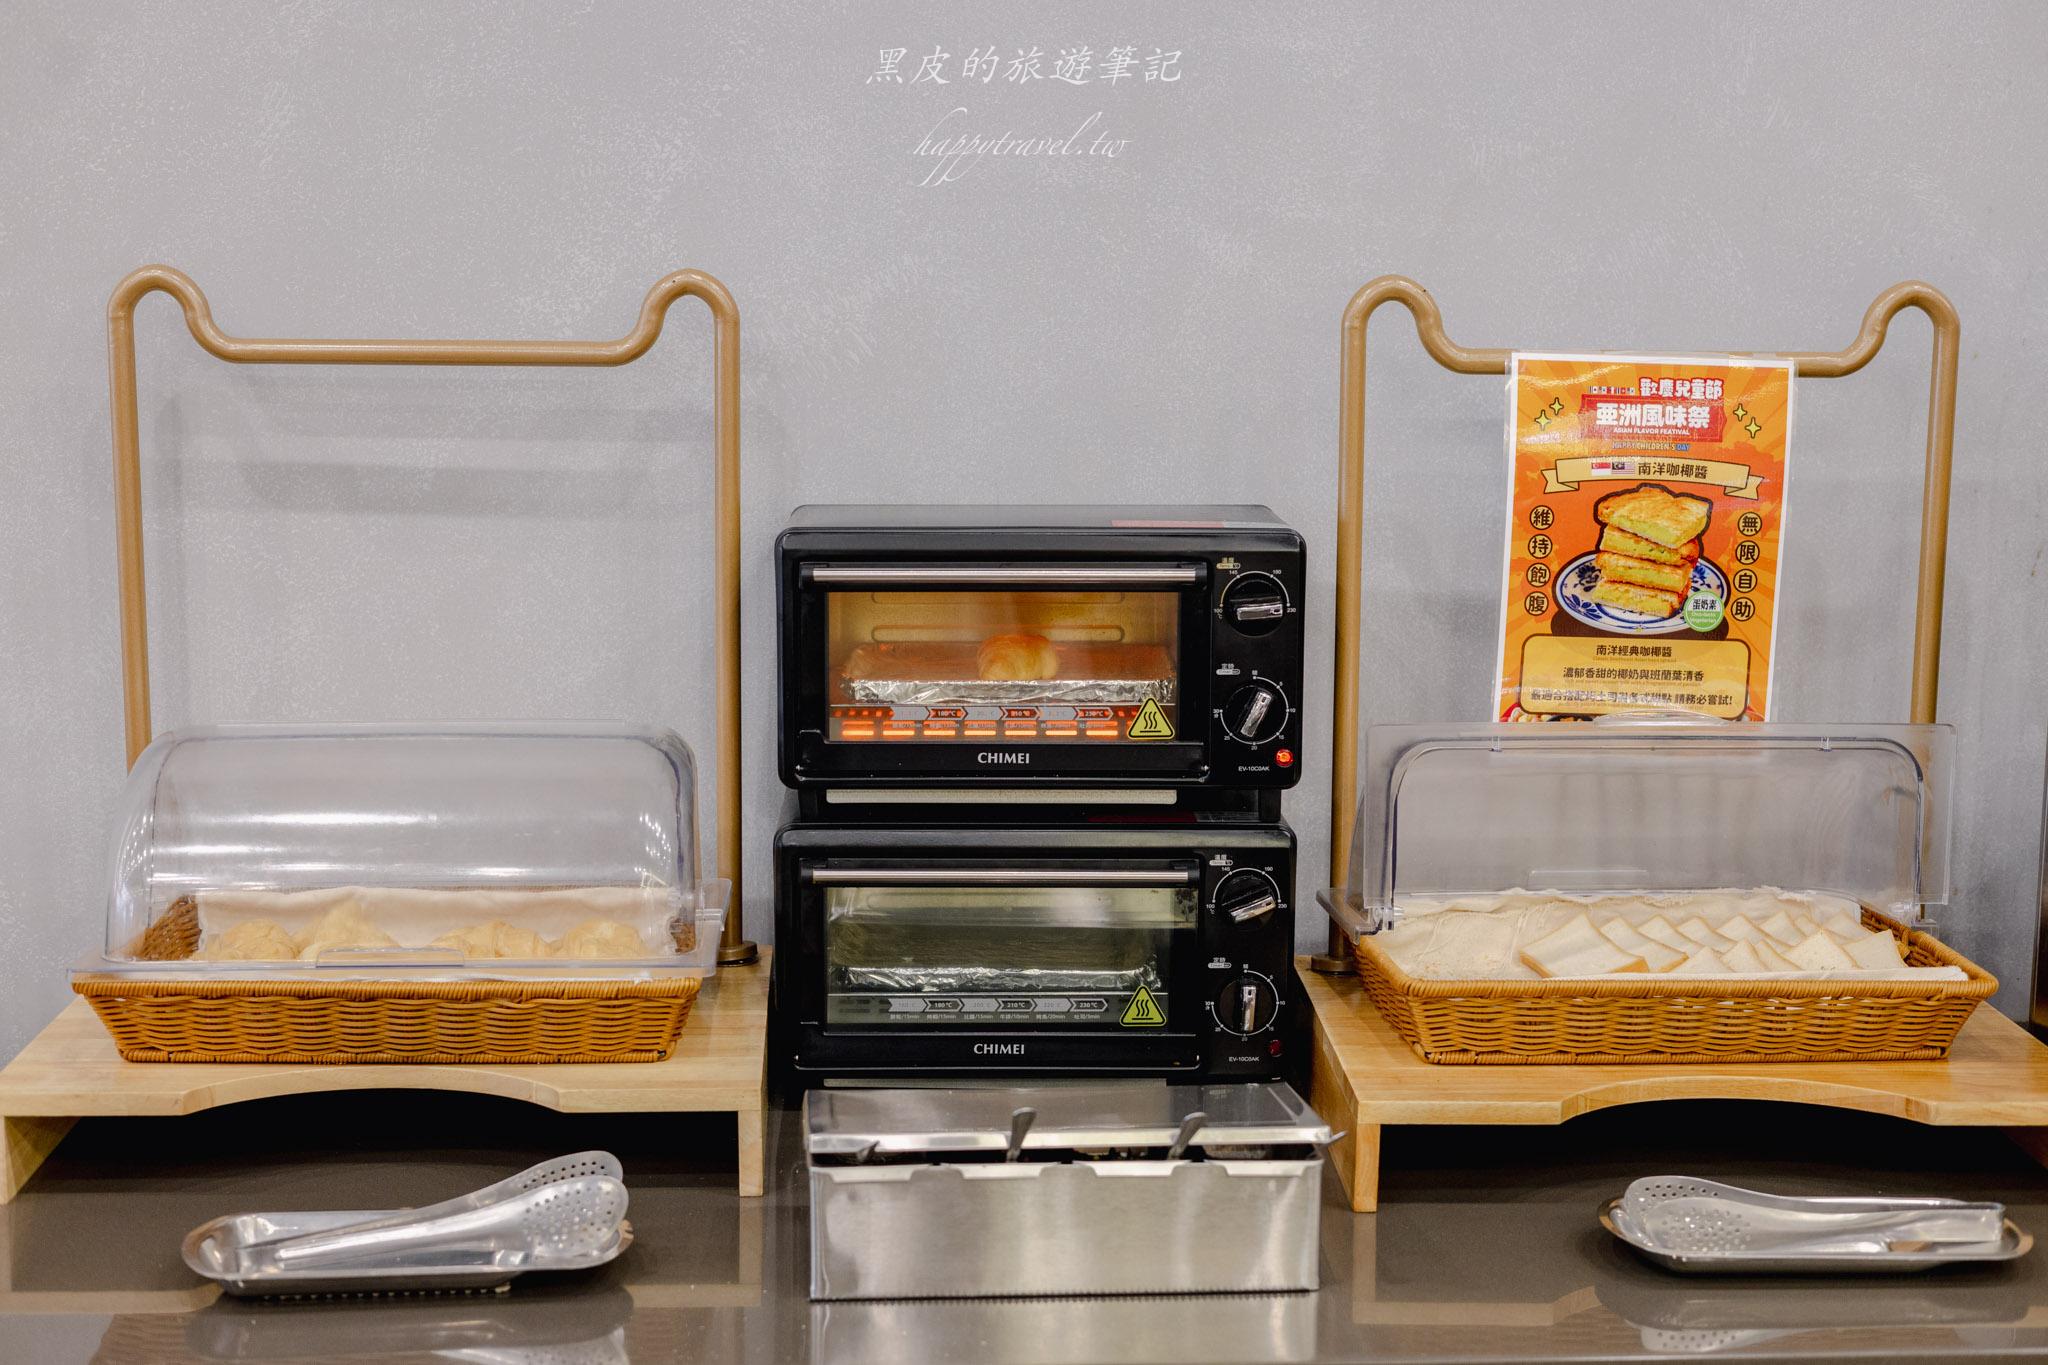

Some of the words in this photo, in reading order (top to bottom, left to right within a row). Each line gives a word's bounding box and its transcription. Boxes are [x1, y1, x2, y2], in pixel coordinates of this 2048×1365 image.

[1640, 377, 1723, 400] 歡慶兒童節
[1638, 462, 1708, 479] 南洋咖椰醬
[1693, 598, 1717, 610] 蛋奶素
[1596, 644, 1672, 657] 南洋經典咖椰醬
[977, 752, 1030, 764] CHIMEI
[973, 1043, 1025, 1055] CHIMEI
